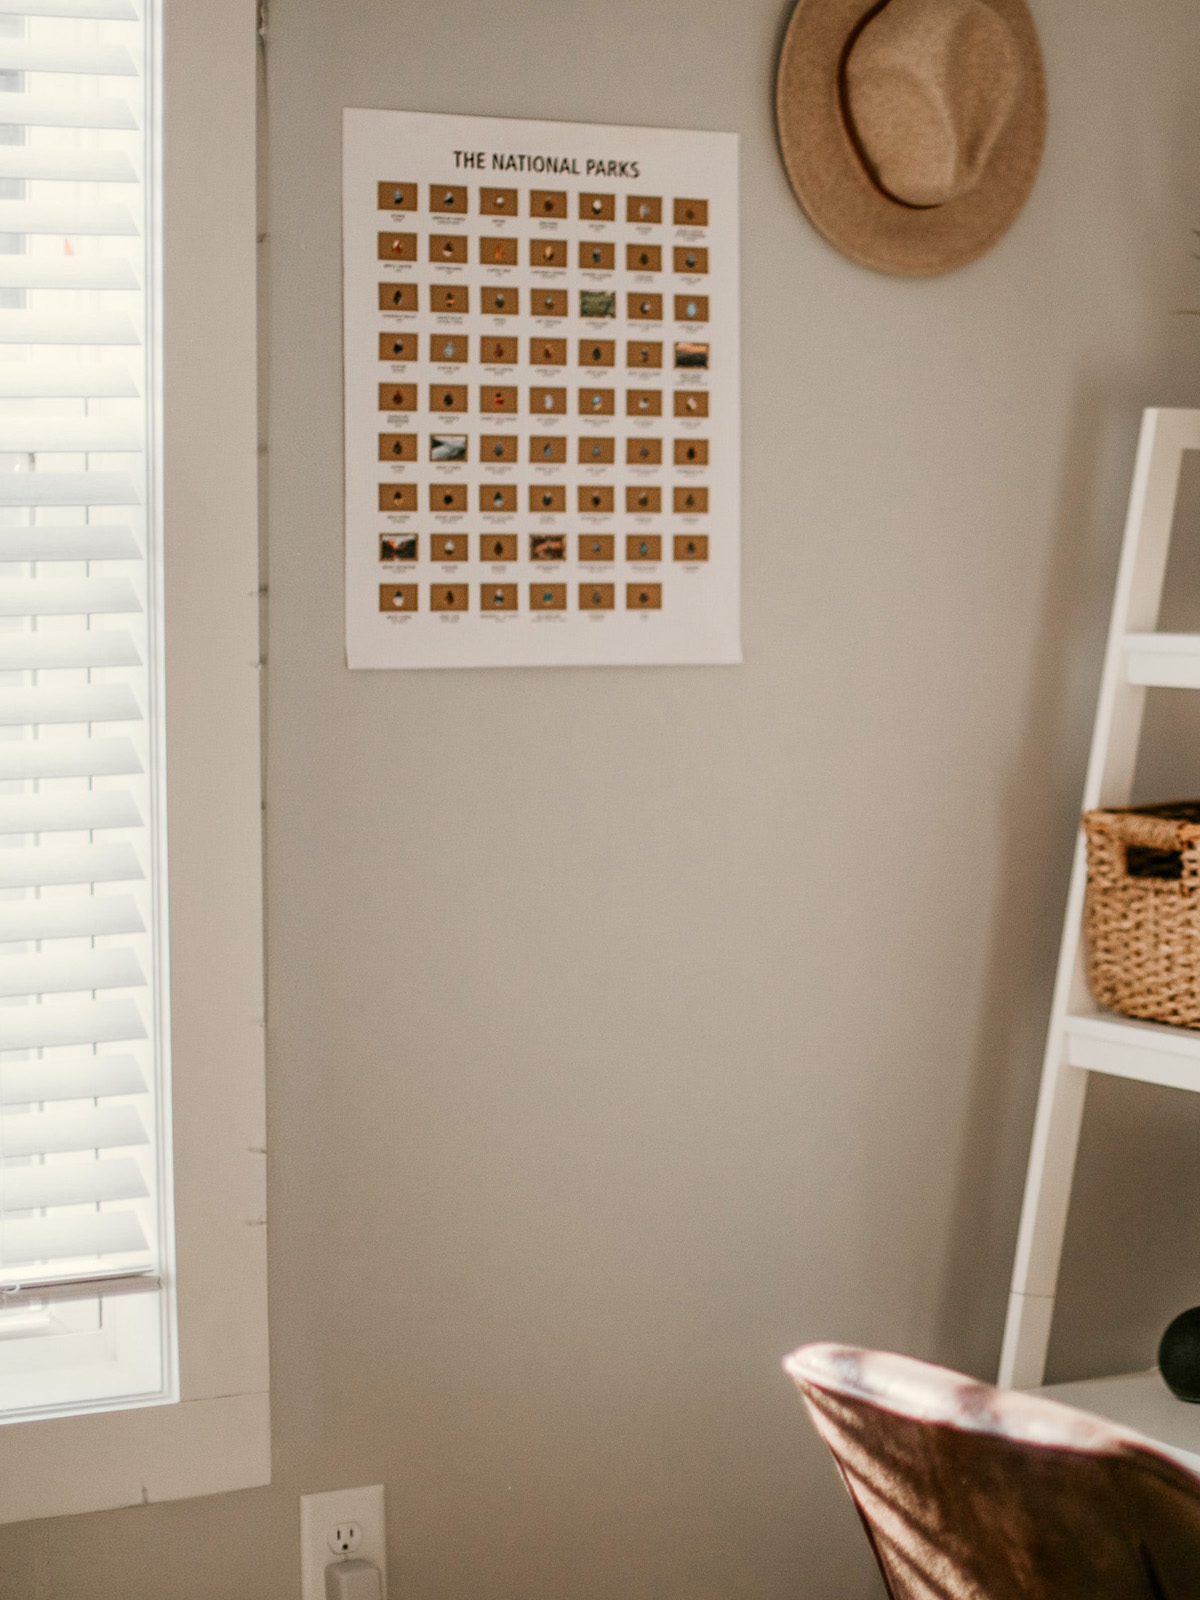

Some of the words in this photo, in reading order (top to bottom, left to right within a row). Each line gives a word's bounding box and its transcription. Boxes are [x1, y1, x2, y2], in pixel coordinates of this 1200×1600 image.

[453, 150, 486, 169] THE
[491, 153, 580, 176] NATIONAL
[586, 158, 641, 179] PARKS
